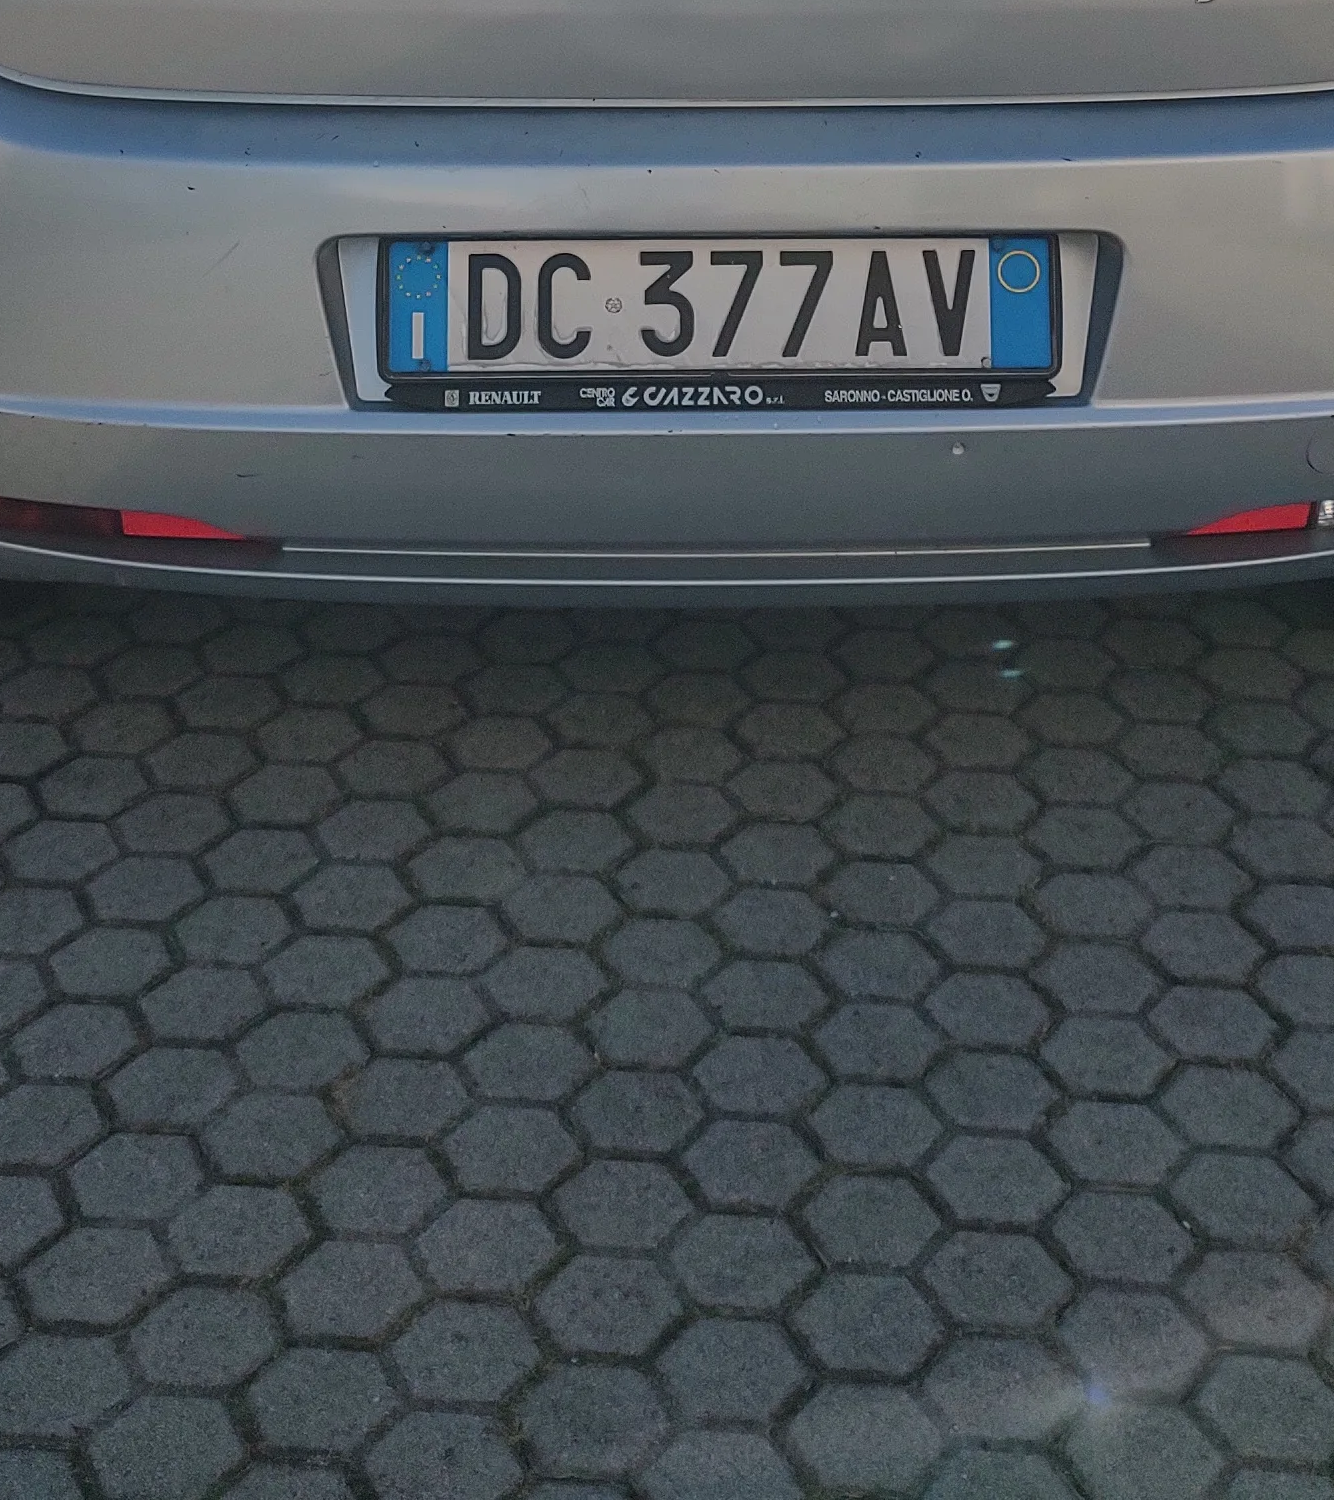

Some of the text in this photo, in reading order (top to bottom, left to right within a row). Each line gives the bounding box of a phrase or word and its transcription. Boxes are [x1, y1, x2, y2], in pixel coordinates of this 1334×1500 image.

[468, 253, 591, 360] DC
[468, 391, 541, 405] RENAULT
[579, 387, 616, 398] CENTRO
[824, 389, 880, 403] SARONNO
[887, 389, 960, 402] CASTIGLIONE
[962, 388, 974, 402] O.
[596, 397, 616, 407] CAR
